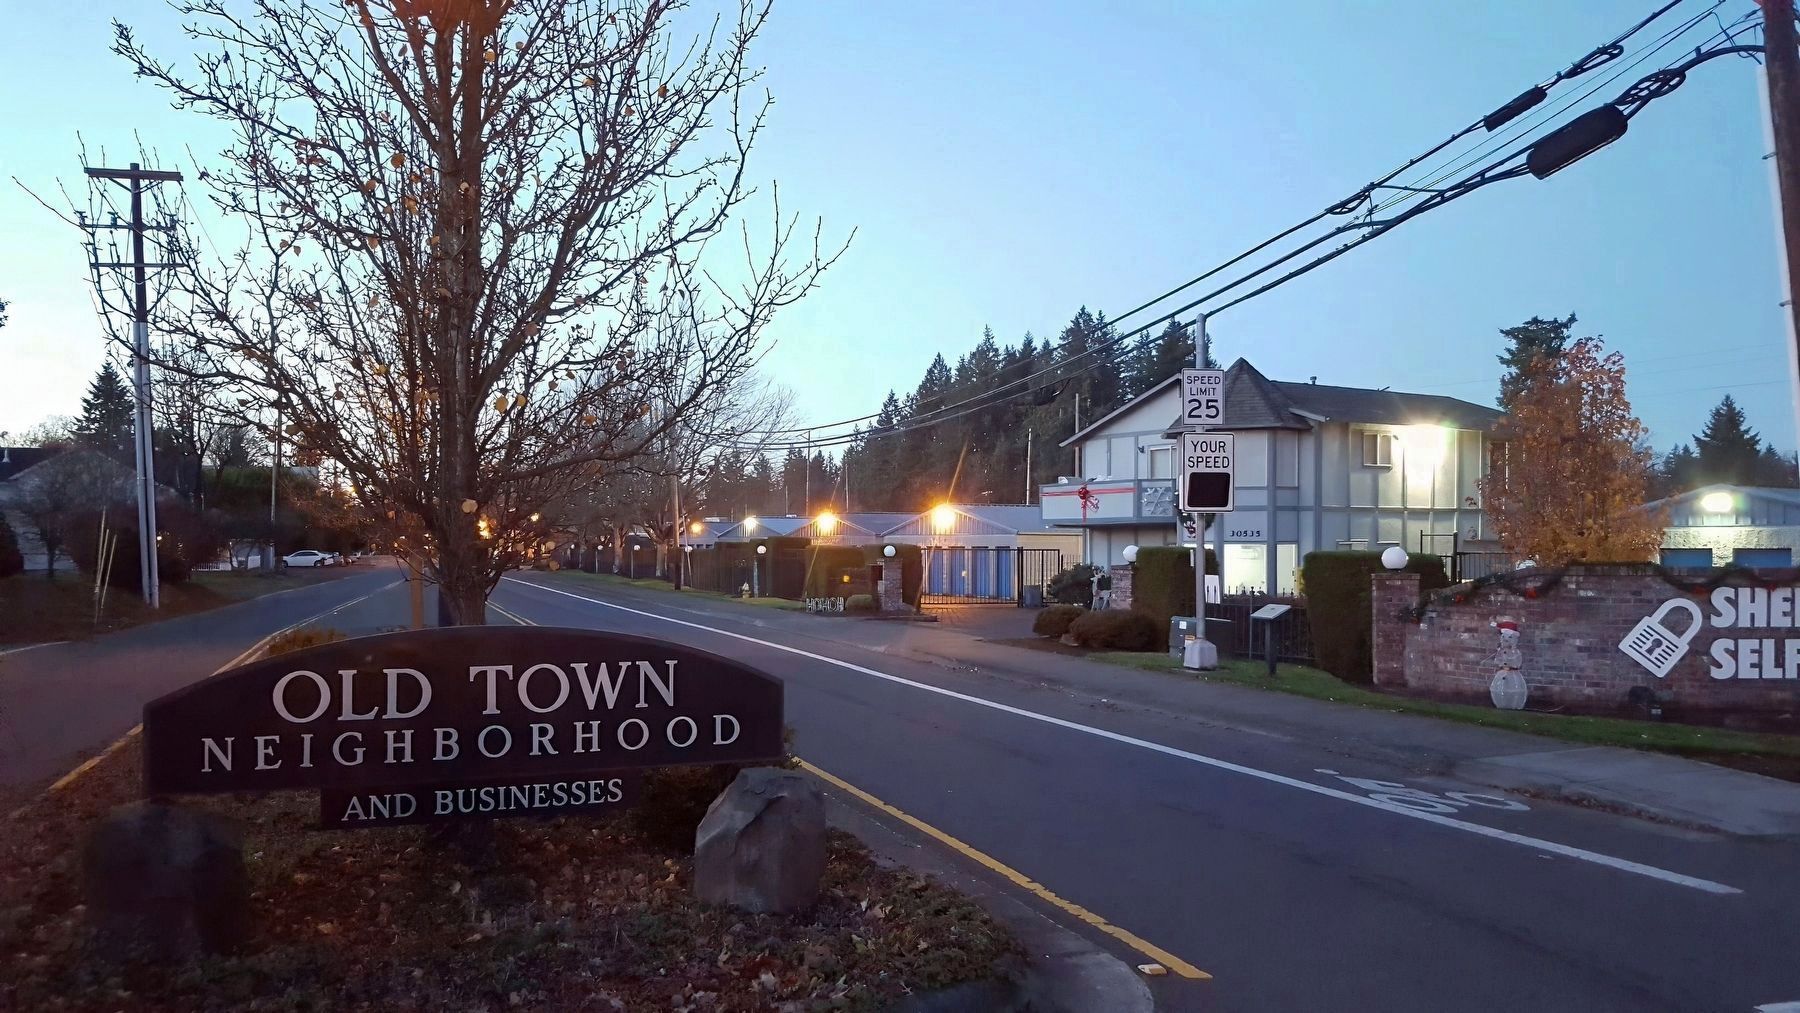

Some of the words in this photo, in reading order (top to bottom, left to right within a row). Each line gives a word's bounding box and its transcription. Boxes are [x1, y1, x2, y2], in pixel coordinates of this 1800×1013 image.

[1186, 375, 1221, 385] SPEED
[1189, 387, 1216, 396] LIMIT
[1187, 398, 1220, 419] 25
[1187, 455, 1230, 469] SPEED
[1190, 440, 1226, 453] YOUR
[1710, 586, 1800, 628] SHE
[1710, 638, 1800, 680] SELF
[272, 668, 432, 723] OLD
[469, 660, 678, 715] TOWN
[200, 714, 741, 772] NEIGHBORHOOD
[341, 793, 417, 821] AND
[434, 778, 623, 815] BUSINESSES
